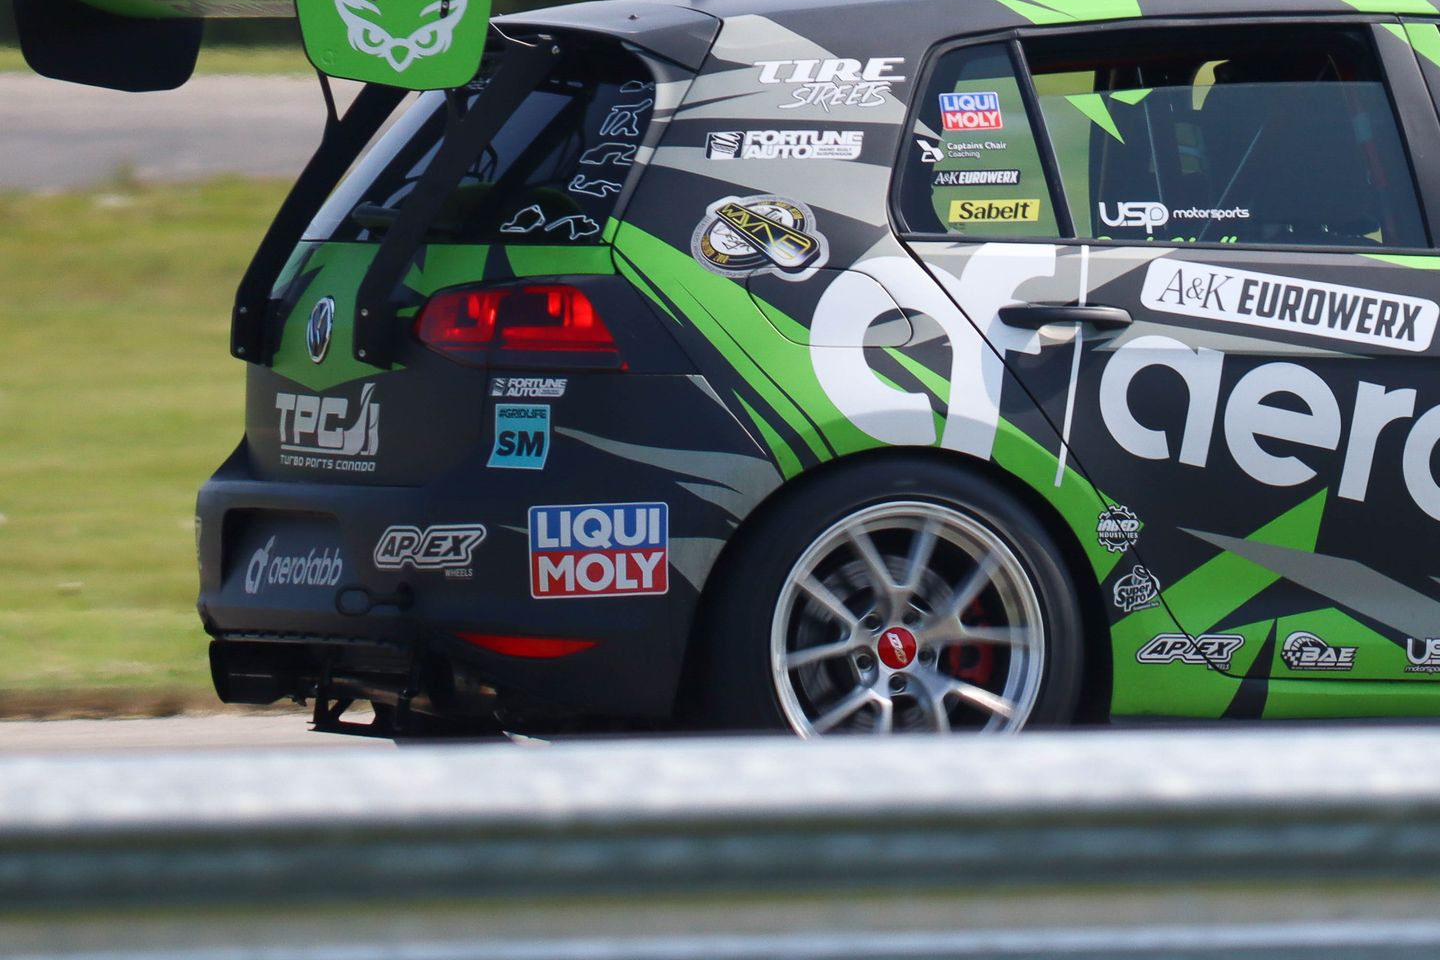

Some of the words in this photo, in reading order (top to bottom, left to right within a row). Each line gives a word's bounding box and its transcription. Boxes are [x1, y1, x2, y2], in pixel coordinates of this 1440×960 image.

[753, 57, 906, 84] TIRE
[778, 82, 892, 113] STREETS
[943, 95, 996, 111] LIQUI
[946, 111, 998, 128] MOLY
[745, 130, 865, 145] FORTUNE
[743, 145, 813, 160] AUTO
[947, 142, 983, 151] Captains
[984, 141, 1007, 150] Chair
[948, 151, 980, 159] Coaching
[934, 172, 959, 184] A&K
[959, 171, 1018, 183] EUROWERX
[958, 201, 1030, 219] Sabelt
[1172, 206, 1250, 221] motorsports
[1156, 267, 1235, 313] A&K
[1236, 277, 1422, 342] EUROWERX
[507, 378, 569, 388] FORTUNE
[505, 387, 542, 397] AUTO
[275, 392, 350, 449] TPC
[495, 430, 545, 457] SM
[536, 507, 661, 549] LIQUI
[267, 546, 344, 586] aerofabb
[445, 569, 473, 578] WHEELS
[538, 551, 665, 593] MOLY
[1300, 646, 1355, 662] BAE
